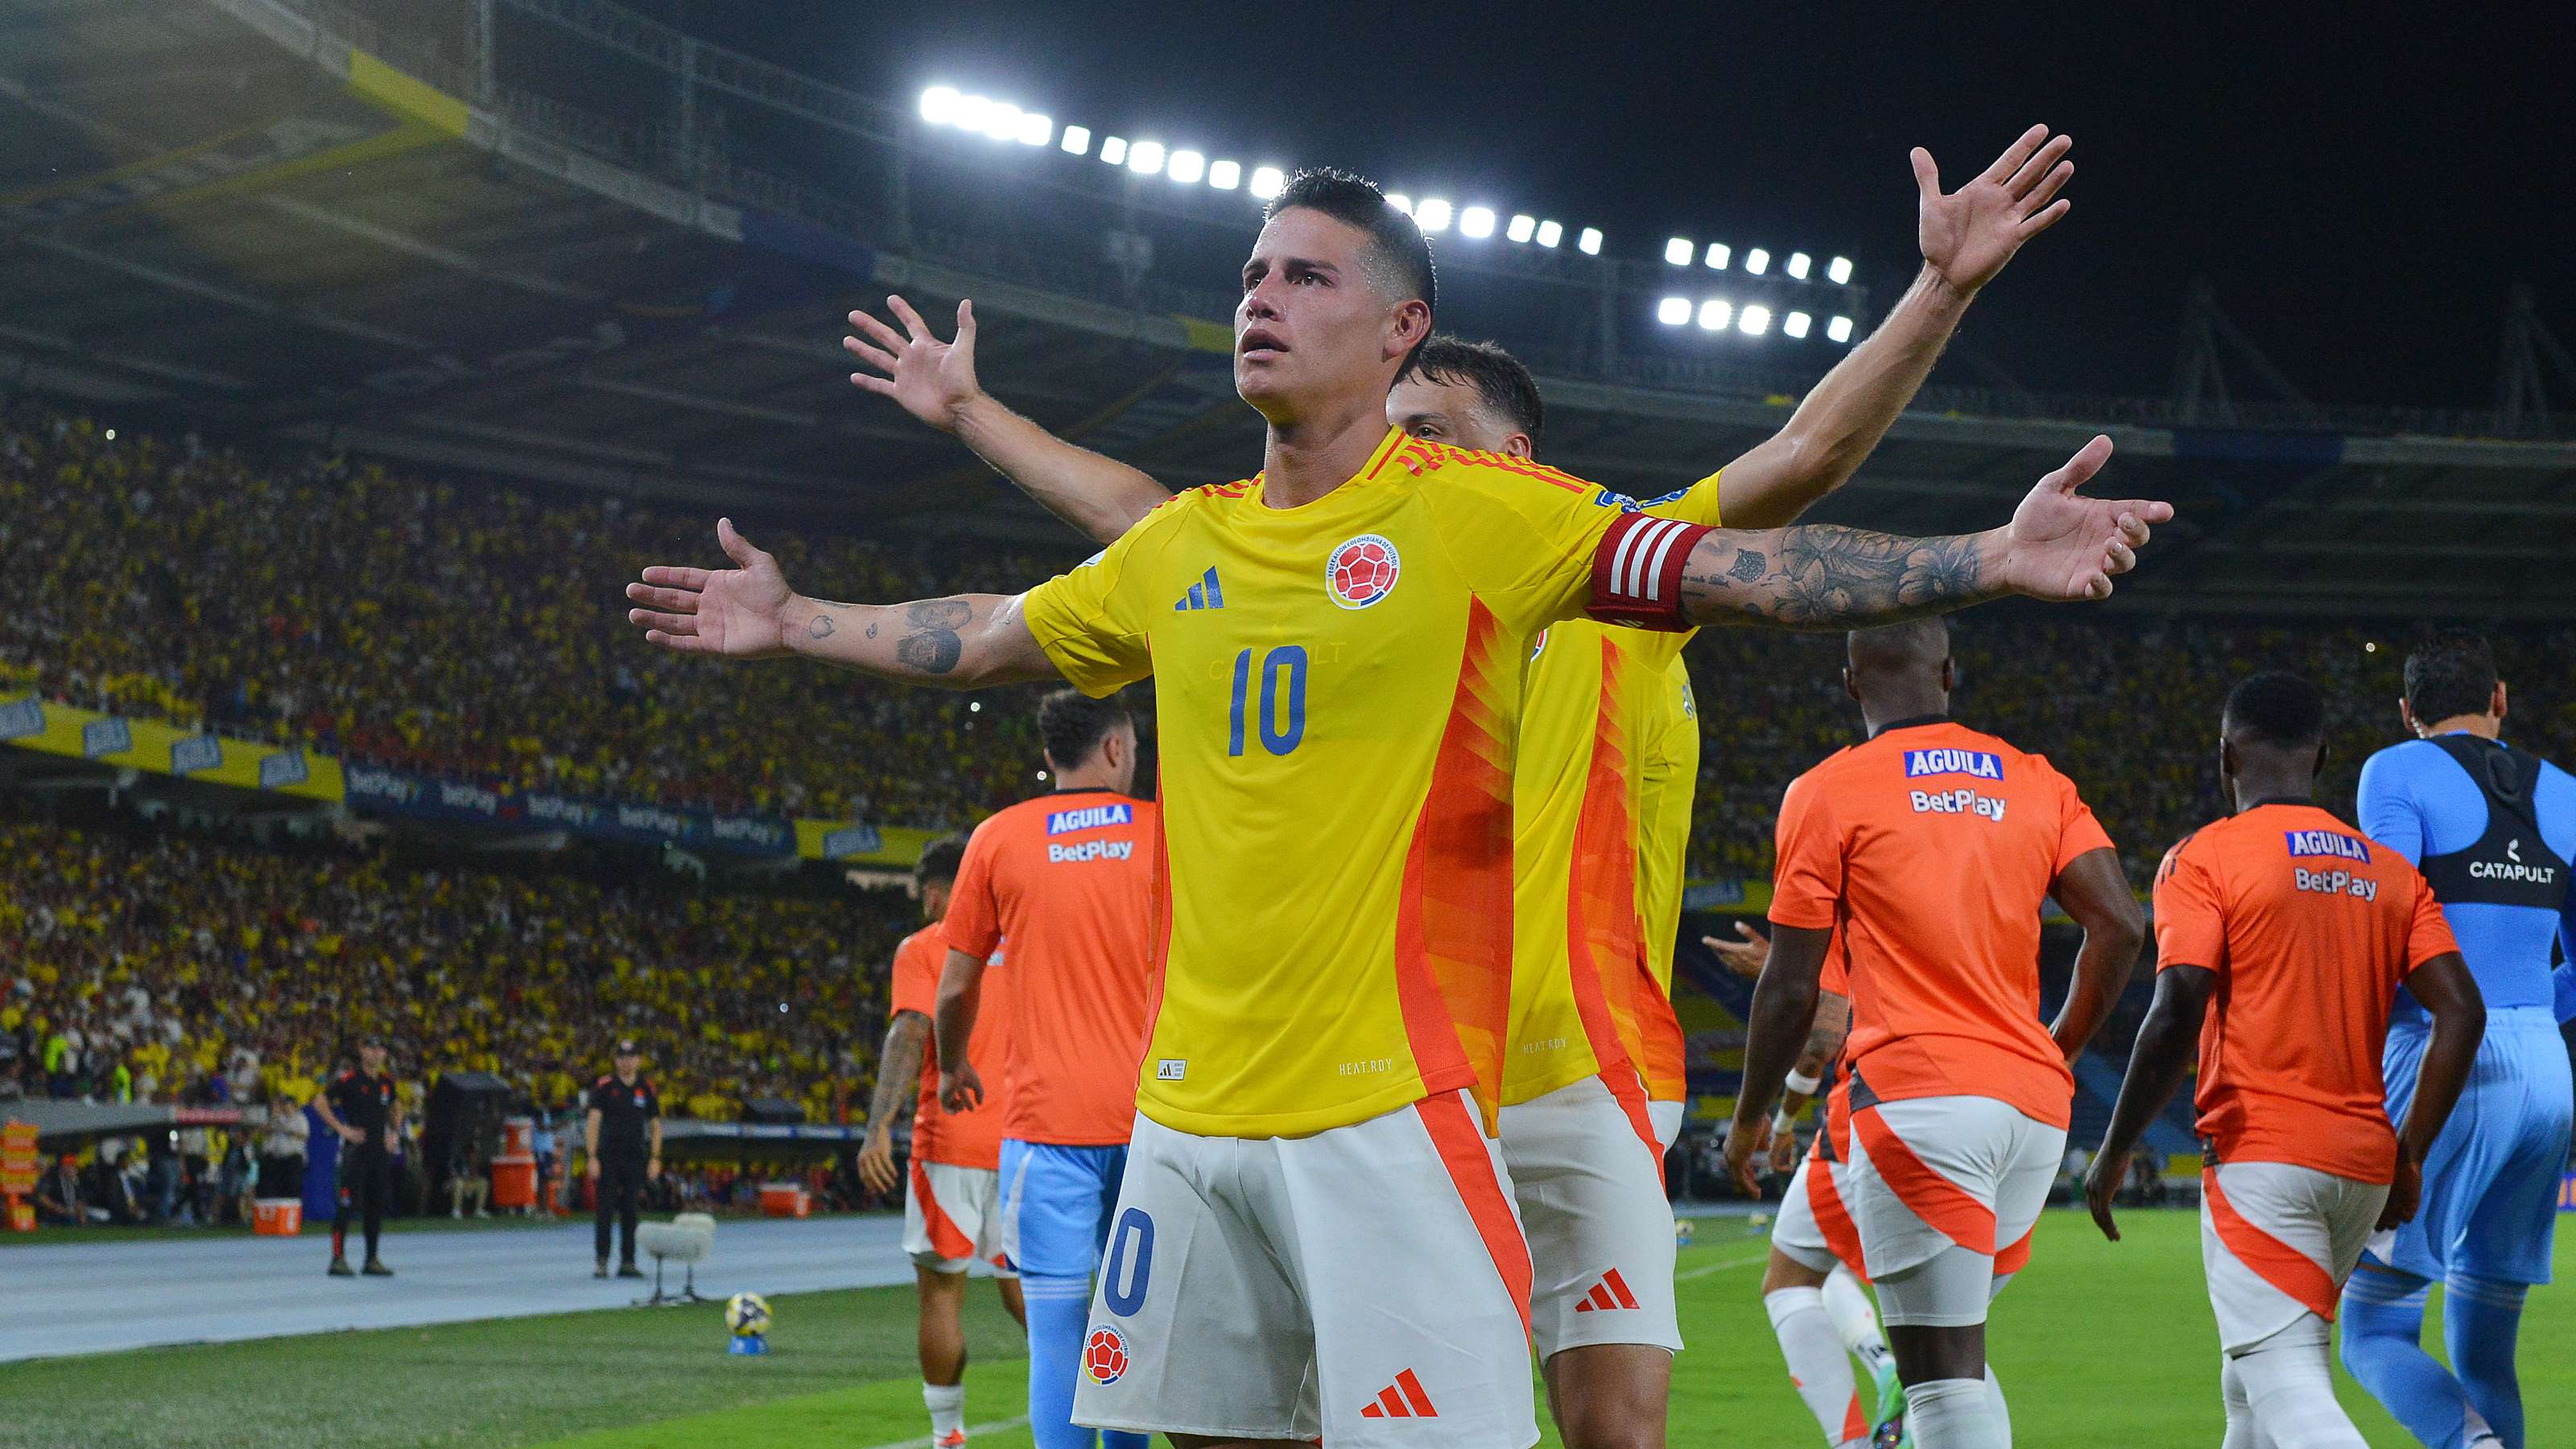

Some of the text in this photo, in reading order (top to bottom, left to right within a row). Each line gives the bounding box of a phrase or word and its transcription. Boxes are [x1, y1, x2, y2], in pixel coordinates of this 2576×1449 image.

[1228, 645, 1308, 756] 10
[1910, 749, 1999, 778] AGUILA
[1909, 789, 2006, 821] BetPlay
[1050, 805, 1128, 835] AGUILA
[1048, 838, 1133, 863] BetPlay
[2294, 831, 2367, 861] AGUILA
[2295, 868, 2377, 902] BetPlay
[2470, 861, 2554, 883] CATAPULT
[1523, 1037, 1567, 1055] HEAT.RDY
[1339, 1059, 1393, 1075] HEAT.RDY
